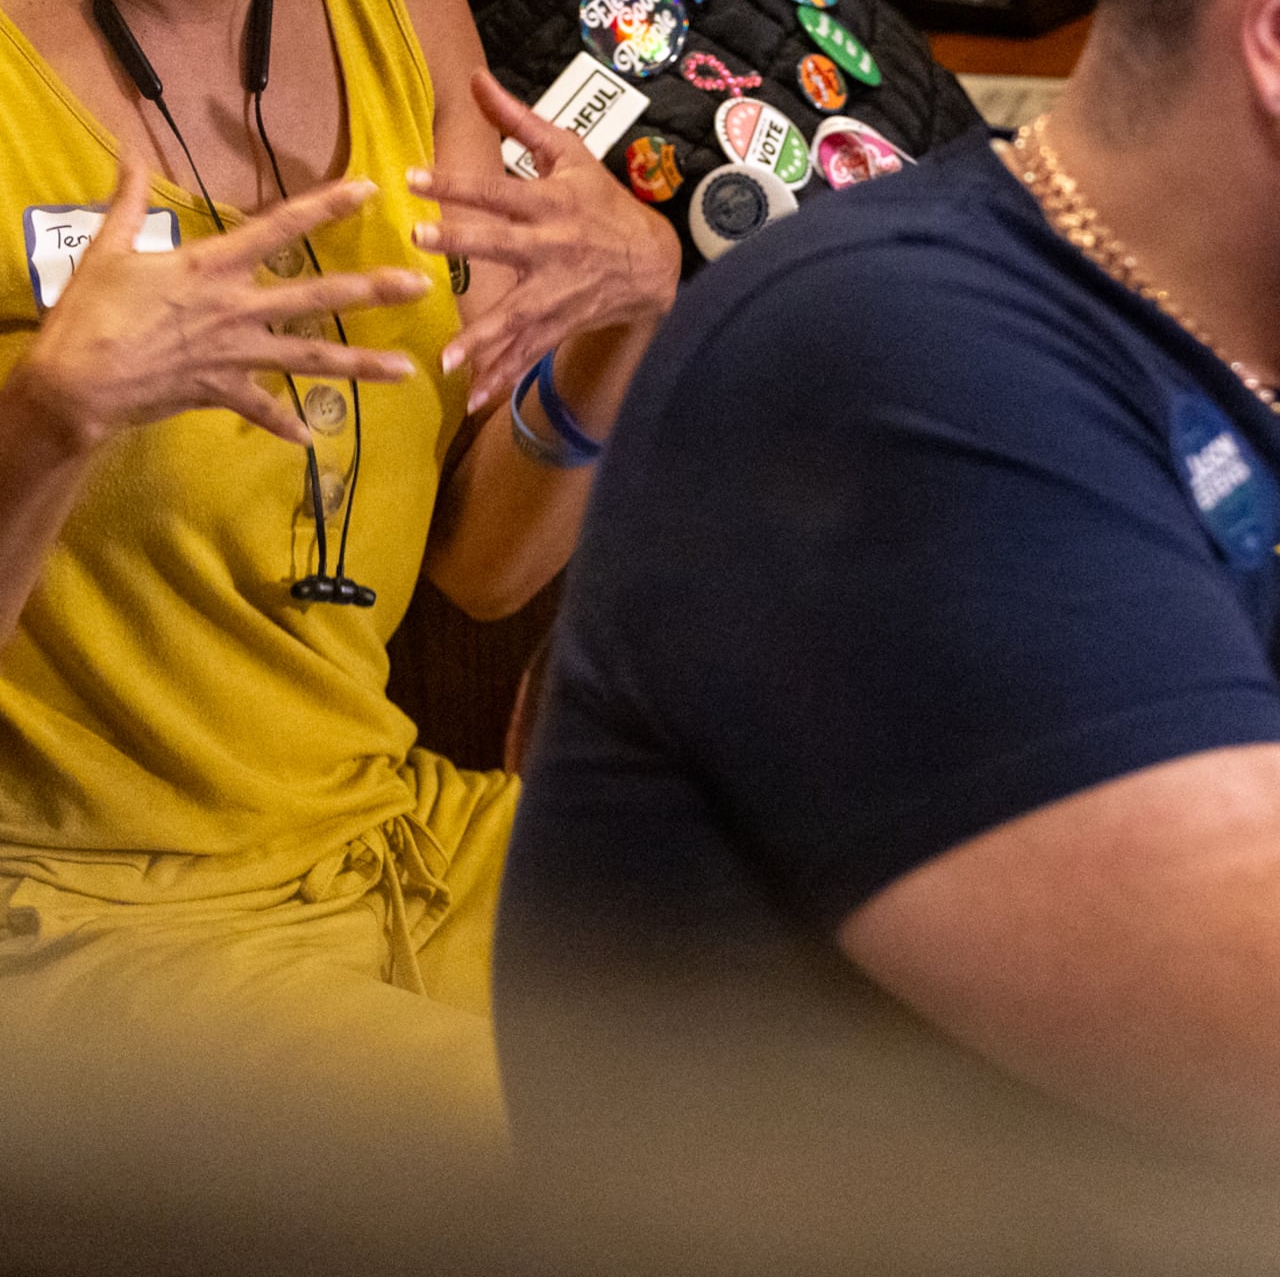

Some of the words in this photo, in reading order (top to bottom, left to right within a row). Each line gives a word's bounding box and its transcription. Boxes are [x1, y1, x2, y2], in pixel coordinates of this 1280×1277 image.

[613, 10, 677, 72] People
[566, 88, 618, 137] HFUL
[757, 120, 784, 166] VOTE
